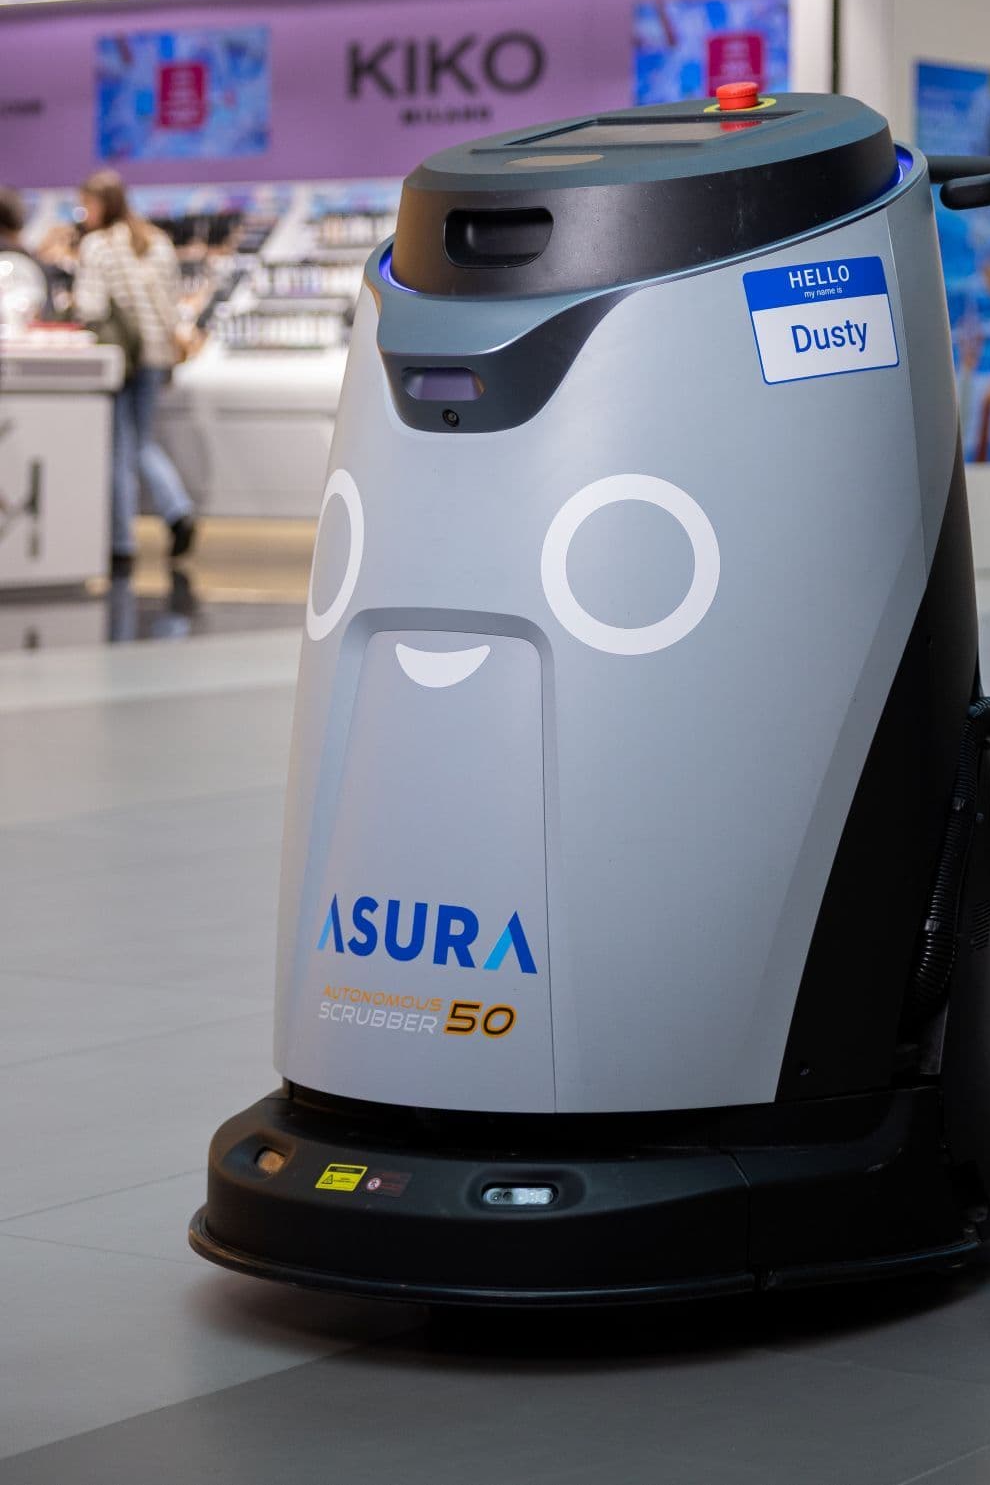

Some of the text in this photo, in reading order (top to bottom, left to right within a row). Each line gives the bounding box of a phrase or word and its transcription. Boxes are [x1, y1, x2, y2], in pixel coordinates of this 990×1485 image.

[347, 29, 547, 100] KIKO
[788, 265, 850, 288] HELLO
[804, 286, 843, 299] my name is
[791, 319, 868, 354] Dusty
[316, 893, 538, 975] ASURA
[322, 982, 443, 1013] AUTONOMOUS
[318, 998, 518, 1040] SCRUBBER 50
